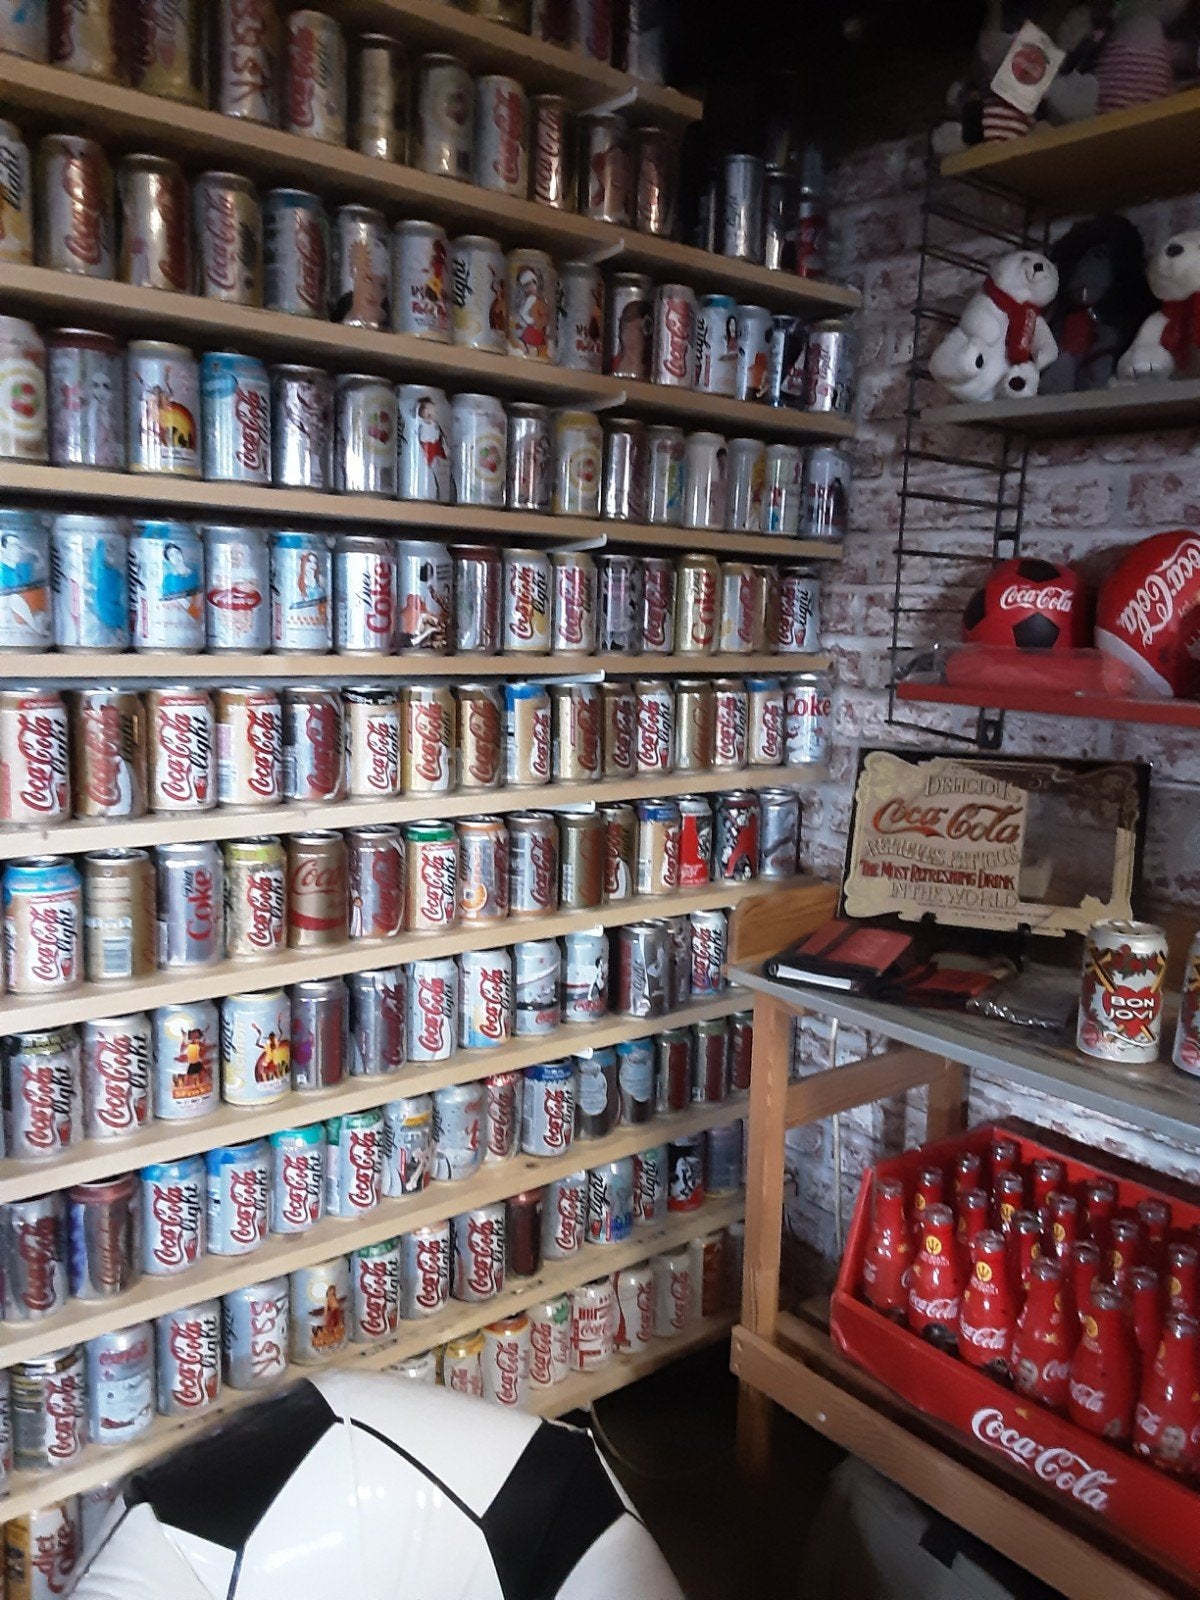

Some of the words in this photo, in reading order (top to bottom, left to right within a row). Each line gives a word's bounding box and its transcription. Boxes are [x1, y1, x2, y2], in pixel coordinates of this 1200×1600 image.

[366, 561, 392, 634] Coke
[999, 584, 1074, 613] Coca-Cola
[158, 709, 194, 802] Coca-Cola
[188, 717, 212, 774] light
[246, 709, 275, 797] Coca-Cola
[367, 720, 392, 791] Coca-Cola
[415, 701, 444, 782] Coca-Cola
[637, 698, 660, 767] Coca-Cola
[656, 702, 672, 744] light
[18, 713, 55, 812] Coca-Cola
[187, 870, 213, 941] Coke
[247, 874, 275, 947] Coca-Cola
[420, 853, 445, 922] Coca-Cola
[441, 856, 457, 902] light
[977, 869, 1016, 891] DRINK
[29, 906, 60, 982] Coca-Cola
[53, 908, 78, 953] light
[707, 928, 724, 969] light
[418, 974, 445, 1053] Coca-Cola
[479, 966, 505, 1040] Coca-Cola
[1109, 1010, 1154, 1020] JOVI
[1110, 995, 1155, 1008] BON
[51, 1063, 77, 1115] light
[97, 1030, 133, 1129] Coca-Cola
[129, 1033, 151, 1090] light
[22, 1064, 55, 1150] Coca-Cola
[542, 1086, 567, 1149] Coca-Cola
[282, 1153, 312, 1225] Coca-Cola
[306, 1153, 323, 1197] light
[348, 1130, 377, 1208] Coca-Cola
[589, 1173, 611, 1219] light
[153, 1183, 185, 1266] Coca-Cola
[179, 1182, 200, 1234] light
[230, 1168, 258, 1245] Coca-Cola
[555, 1186, 579, 1251] Coca-Cola
[416, 1239, 441, 1309] Coca-Cola
[468, 1217, 495, 1296] Coca-Cola
[360, 1260, 389, 1338] Coca-Cola
[170, 1319, 203, 1408] Coca-Cola
[199, 1315, 219, 1372] light
[496, 1341, 519, 1406] Coca-Cola
[530, 1321, 552, 1384] Coca-Cola
[970, 1406, 1118, 1511] Coca-Cola
